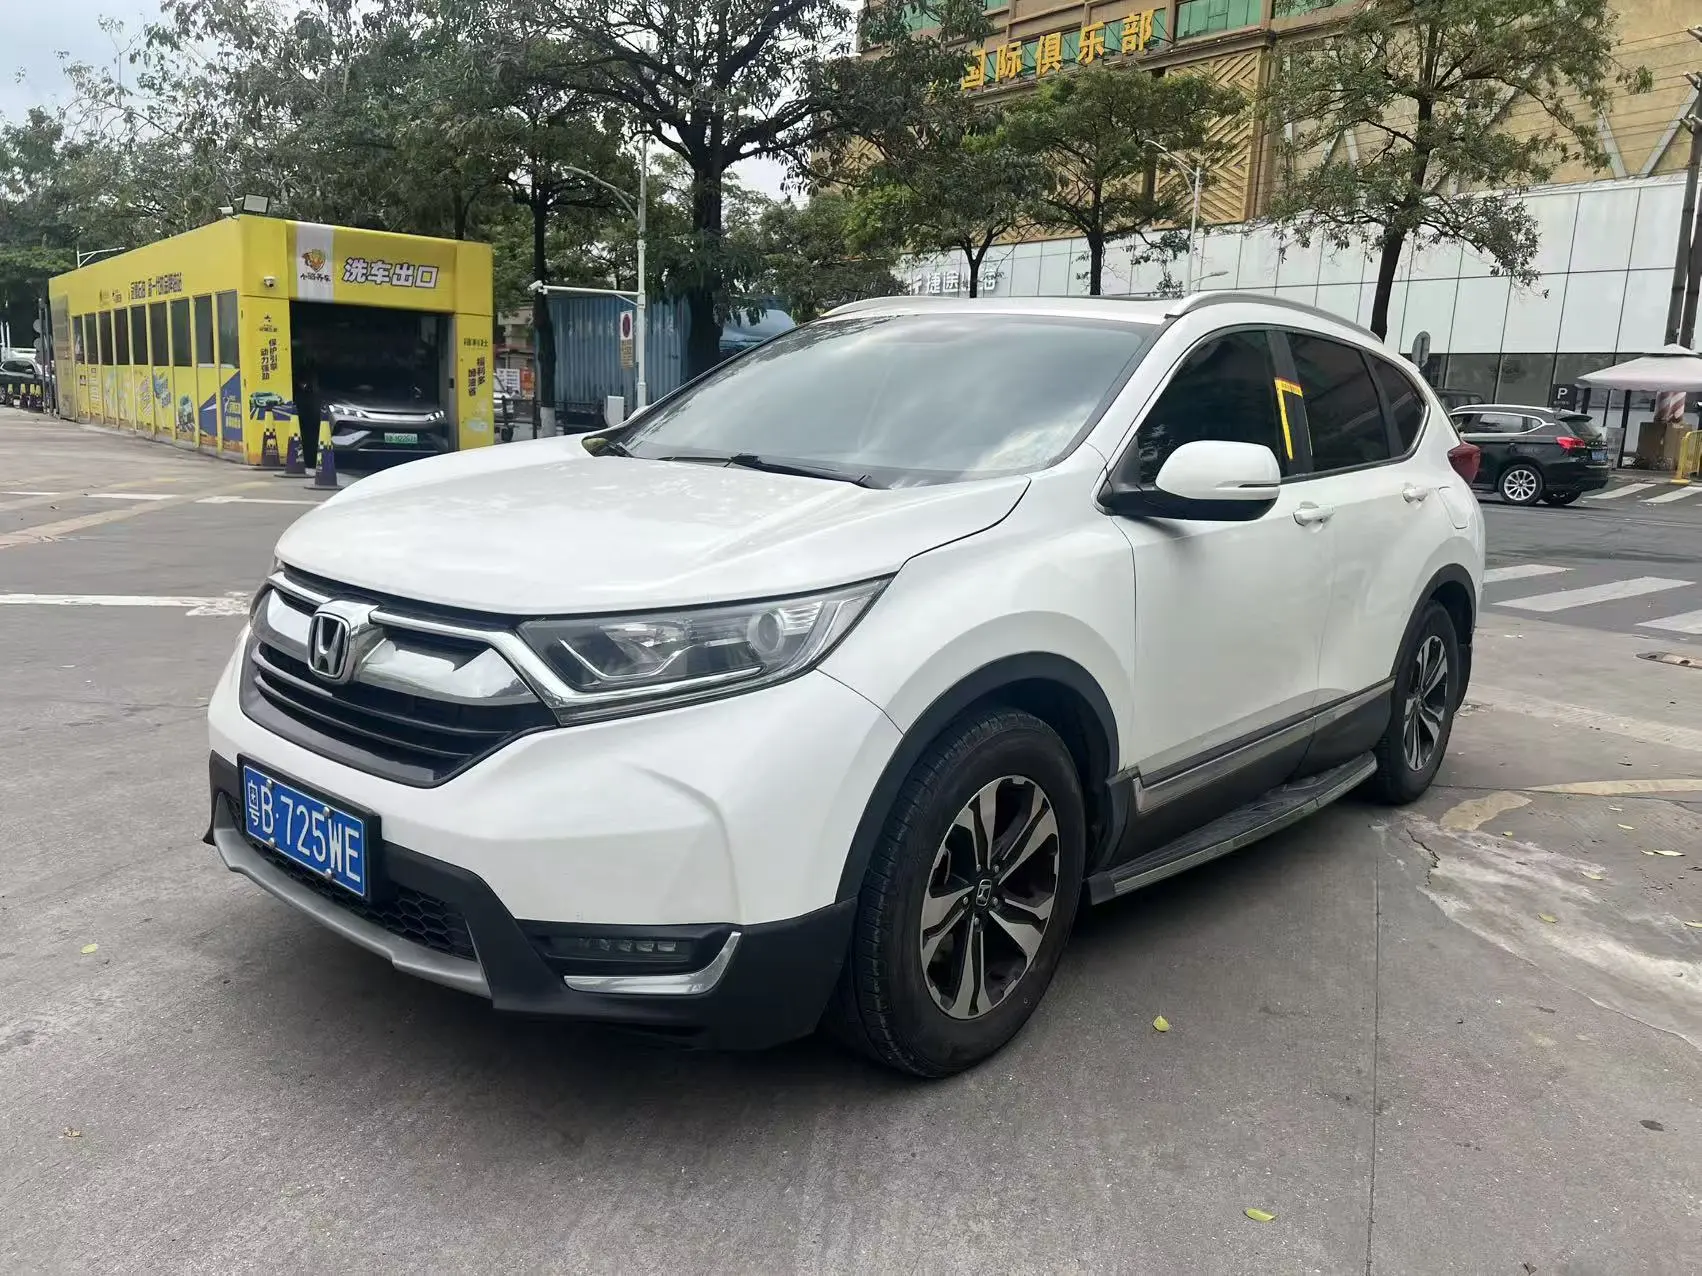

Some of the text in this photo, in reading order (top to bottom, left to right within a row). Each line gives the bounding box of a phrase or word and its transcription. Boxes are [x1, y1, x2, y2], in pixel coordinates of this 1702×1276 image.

[961, 8, 1154, 91] 国际俱乐部
[342, 257, 439, 288] 洗车出口
[1557, 387, 1568, 400] P
[247, 780, 361, 883] 粤B·725WE
